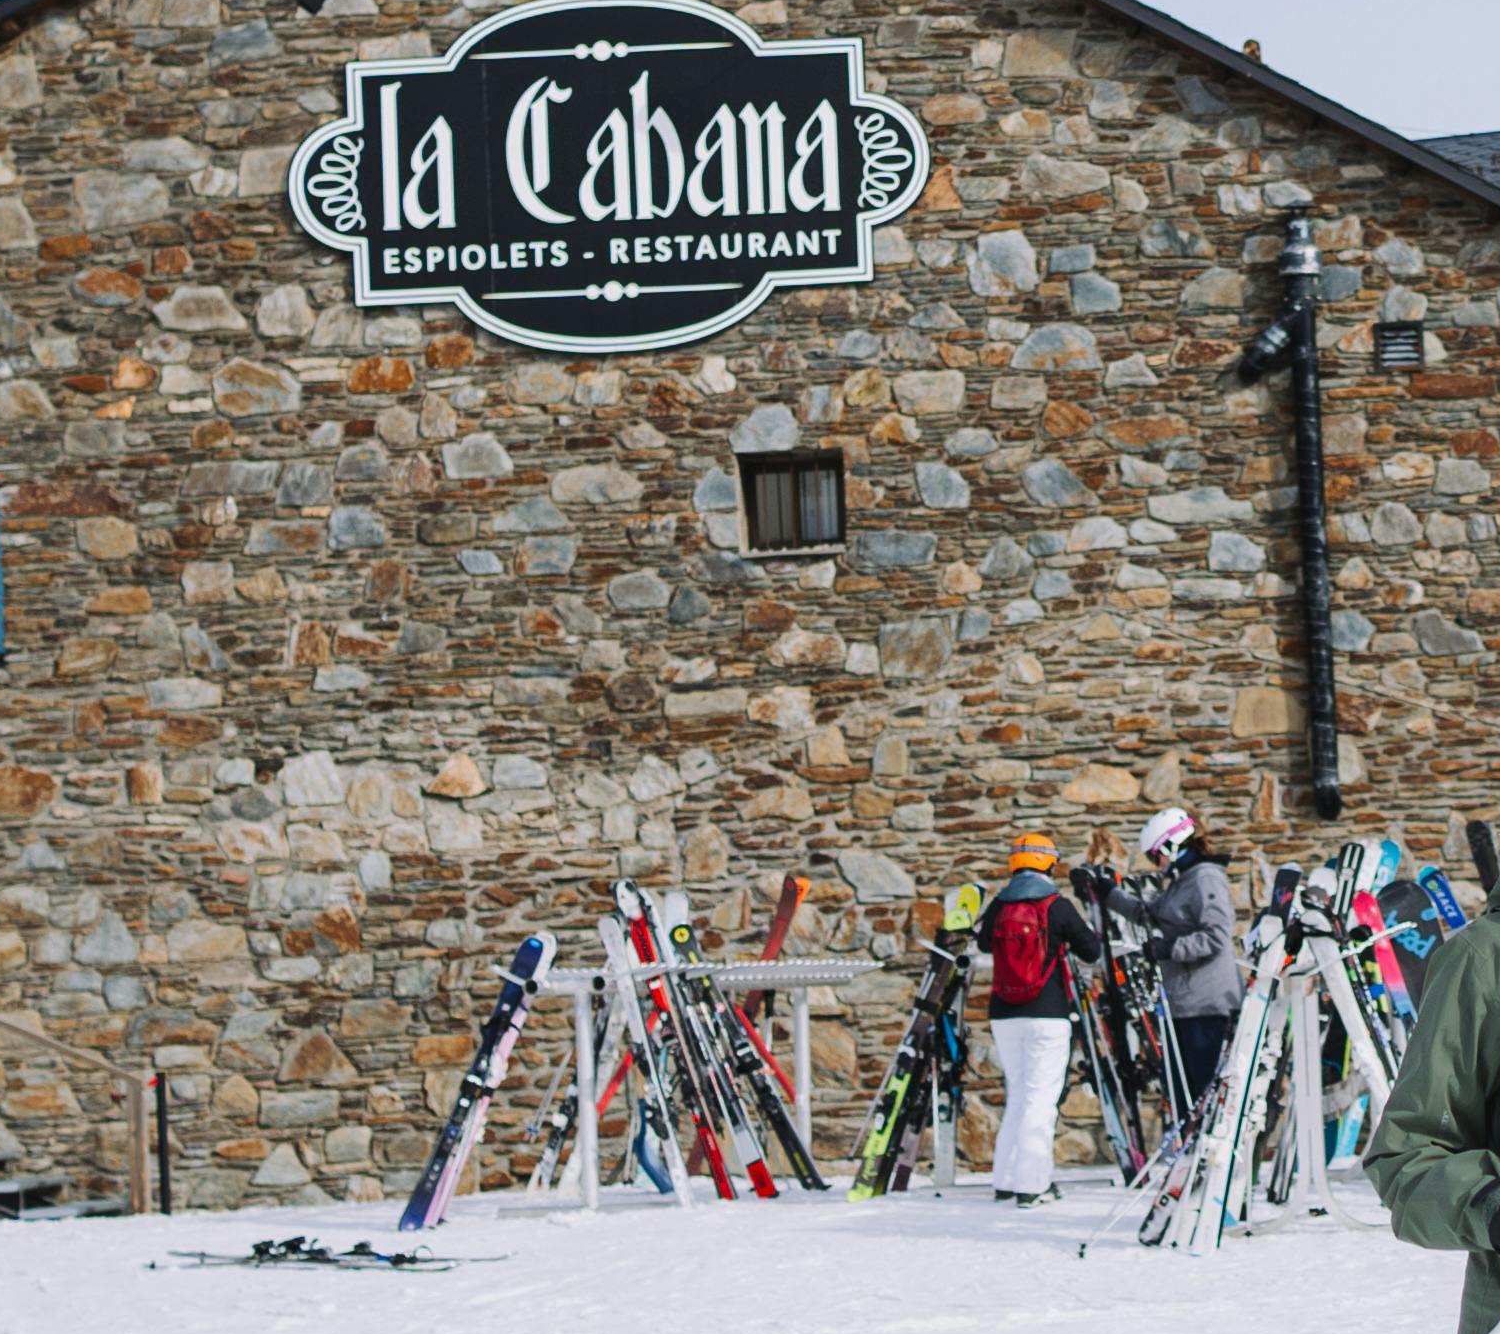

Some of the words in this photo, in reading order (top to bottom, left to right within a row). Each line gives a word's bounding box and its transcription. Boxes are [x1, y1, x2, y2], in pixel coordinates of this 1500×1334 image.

[379, 81, 457, 231] la
[505, 70, 843, 223] Cabana
[382, 240, 569, 275] ESPIOLETS
[609, 229, 843, 265] RESTAURANT
